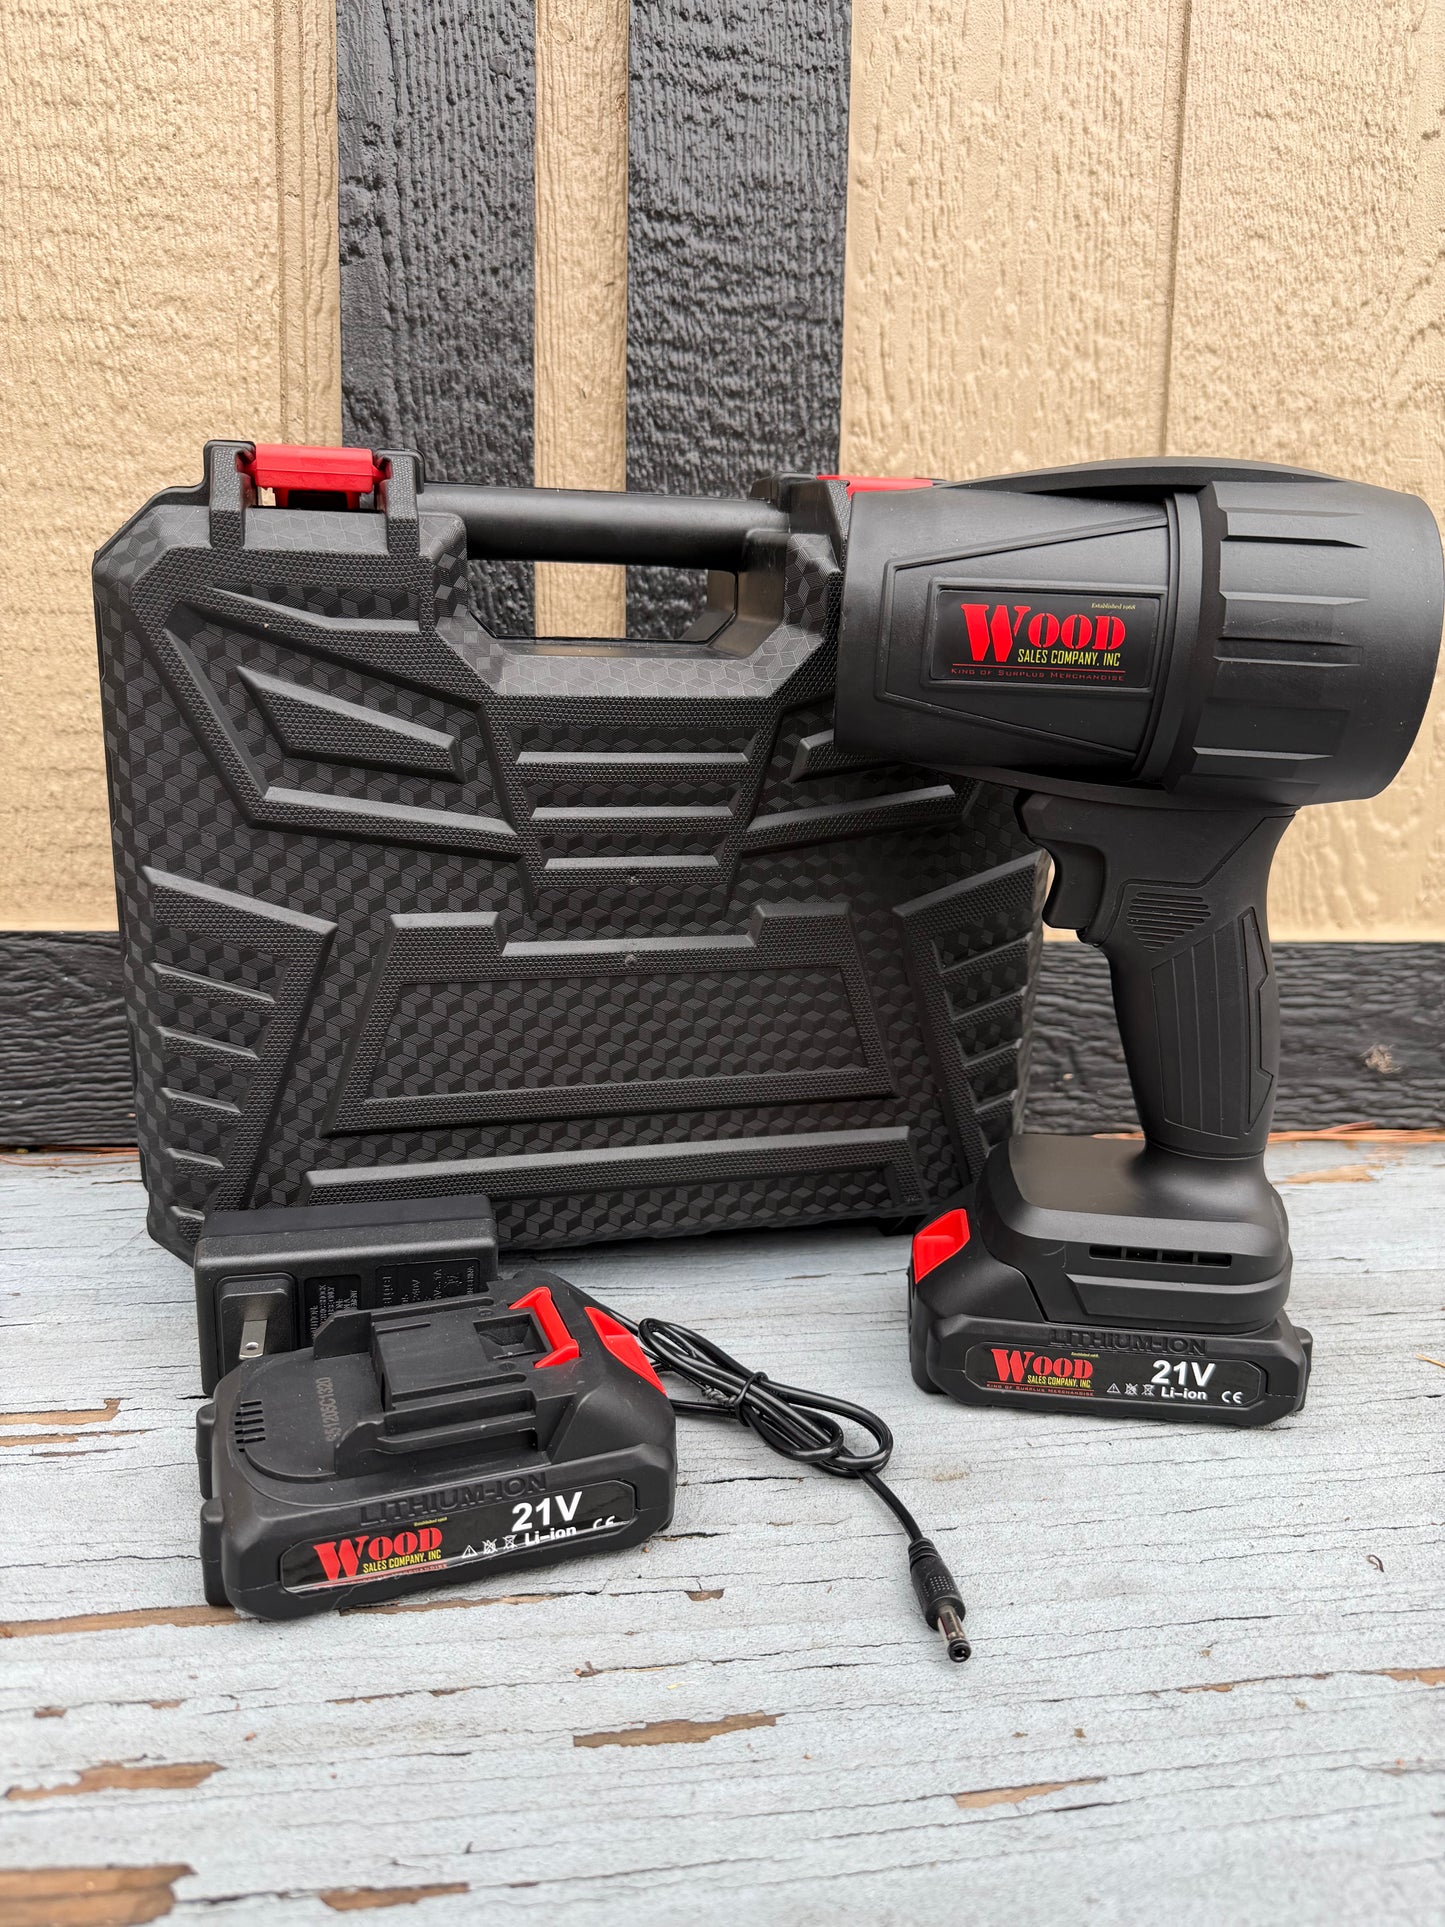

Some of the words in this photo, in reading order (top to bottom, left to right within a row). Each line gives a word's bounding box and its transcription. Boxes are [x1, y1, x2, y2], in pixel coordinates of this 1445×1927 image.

[961, 603, 1126, 662] WOOD
[1017, 649, 1048, 664] SALES
[1103, 652, 1121, 667] INC
[998, 670, 1045, 679] SURPLUS
[1050, 672, 1124, 681] MERCHANDISE
[1051, 1329, 1206, 1356] LITHIUM-ION
[991, 1348, 1093, 1383] WOOD
[1151, 1359, 1215, 1387] 21V
[1027, 1375, 1047, 1385] SALES
[1080, 1379, 1091, 1388] INC
[1161, 1386, 1208, 1401] Li-ion
[360, 1471, 547, 1526] LITHIUM-ION
[511, 1491, 582, 1533] 21V
[312, 1527, 443, 1581] WOOD
[362, 1559, 387, 1574] SALES
[428, 1549, 441, 1561] INC
